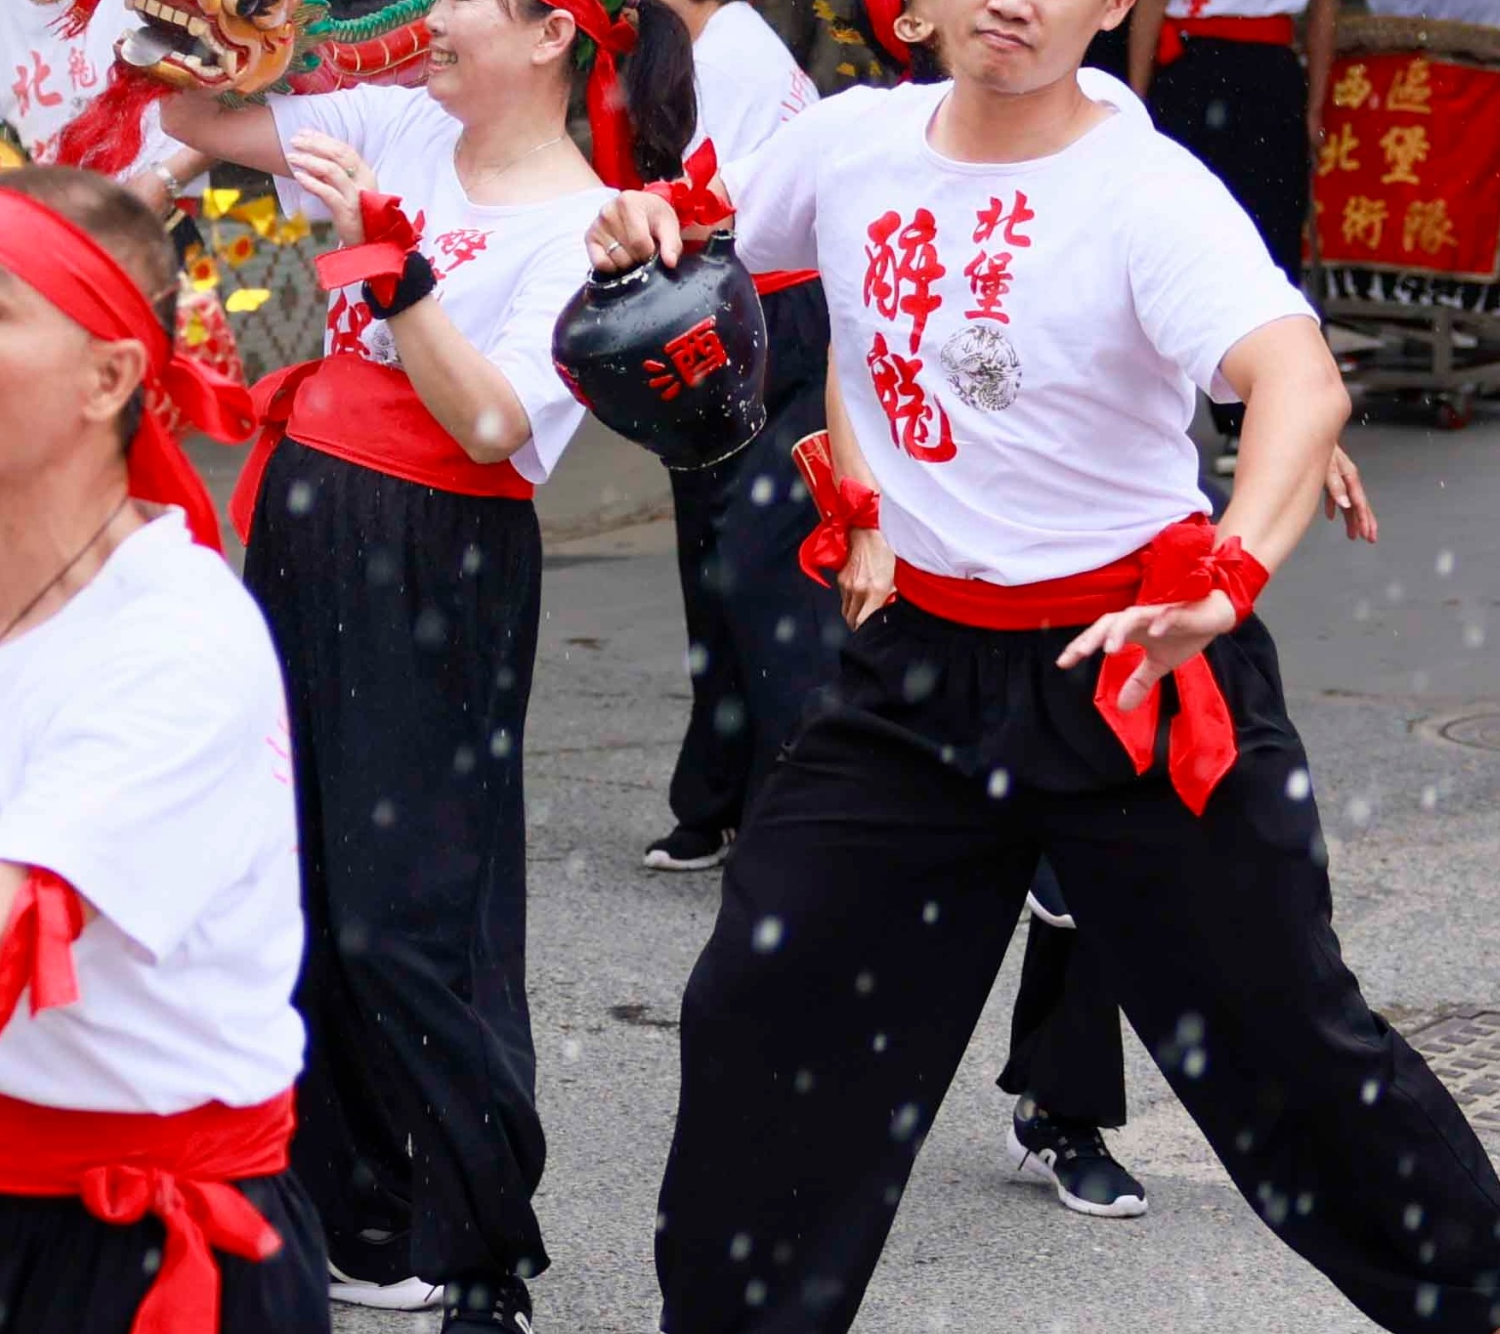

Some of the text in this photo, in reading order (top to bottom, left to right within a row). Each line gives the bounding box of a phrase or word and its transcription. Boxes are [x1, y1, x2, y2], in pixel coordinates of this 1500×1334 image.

[964, 190, 1035, 325] 北堡
[643, 314, 728, 402] 酒
[863, 207, 958, 463] 醉龍
